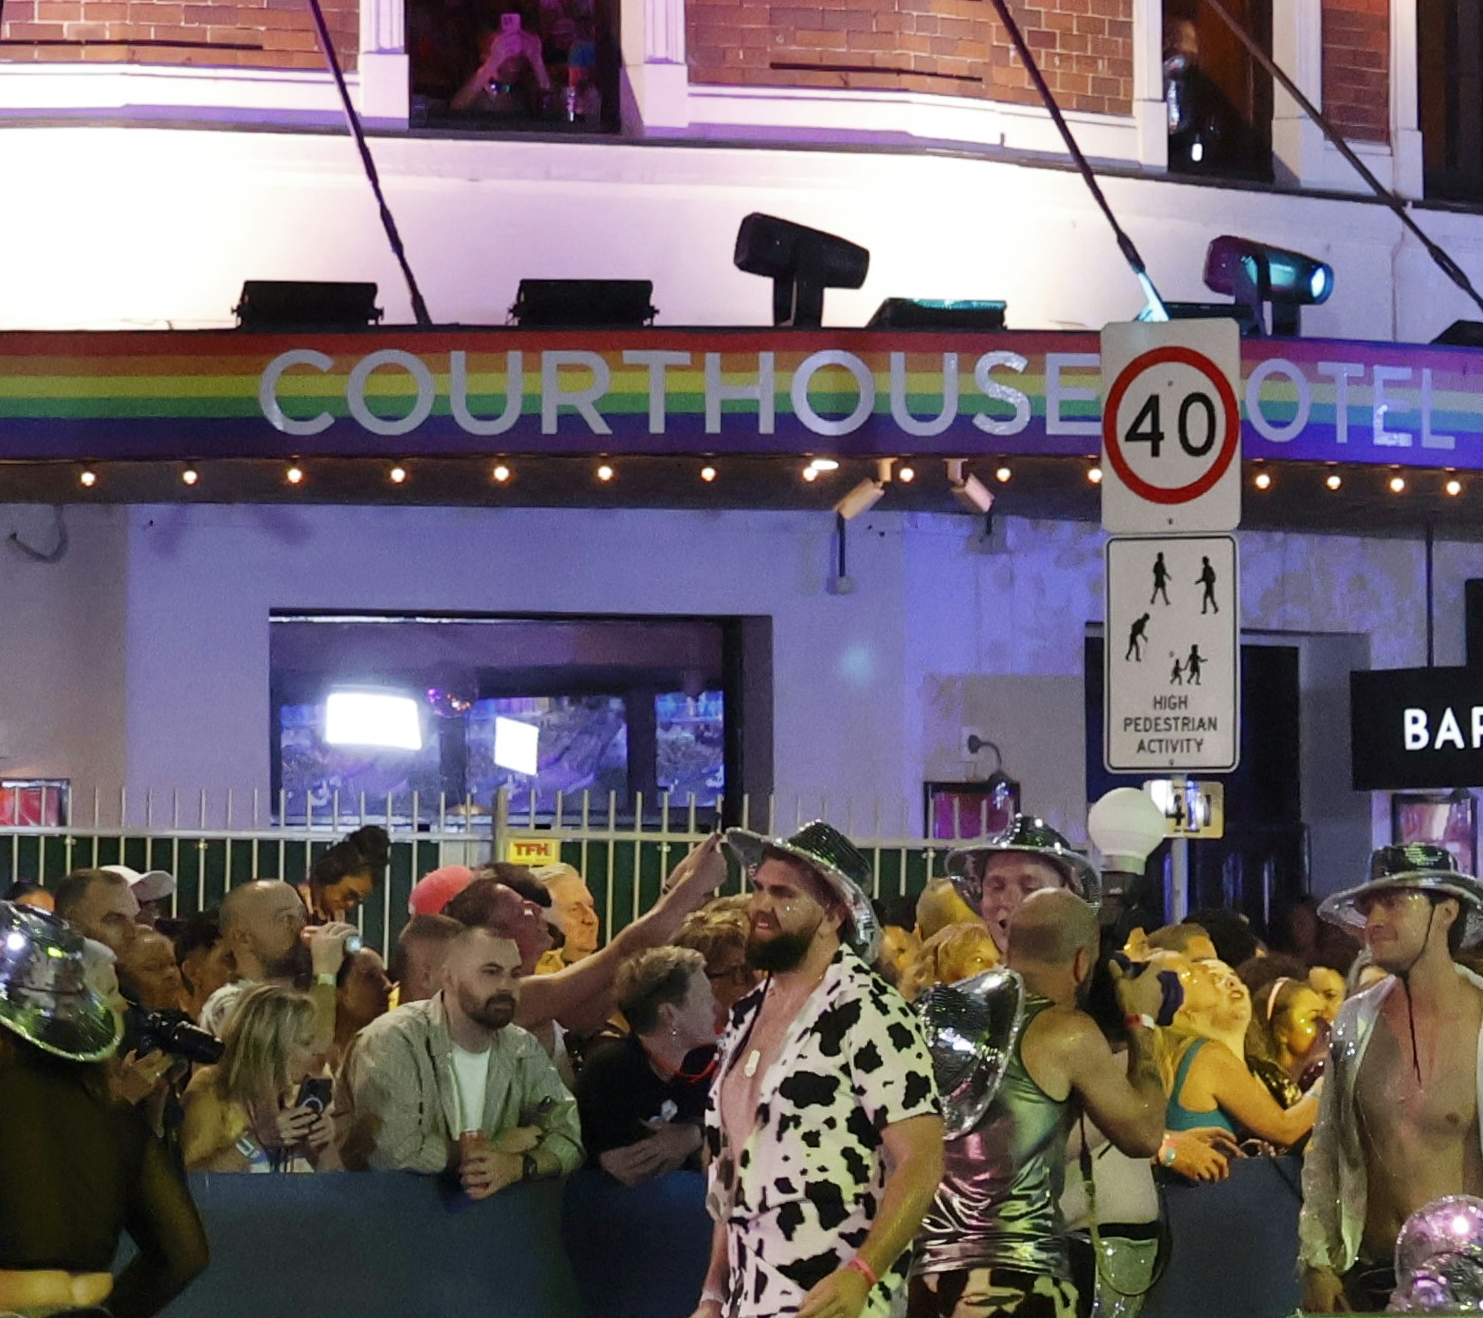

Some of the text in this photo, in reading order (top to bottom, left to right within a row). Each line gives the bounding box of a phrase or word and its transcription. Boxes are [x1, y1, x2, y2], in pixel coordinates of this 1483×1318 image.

[259, 348, 1457, 450] COURTHOUSE OTEL
[1125, 392, 1216, 457] 40
[1153, 695, 1188, 710] HIGH
[1124, 717, 1217, 732] PEDESTRIAN
[1136, 738, 1204, 753] ACTIVITY
[514, 843, 551, 856] TFH
